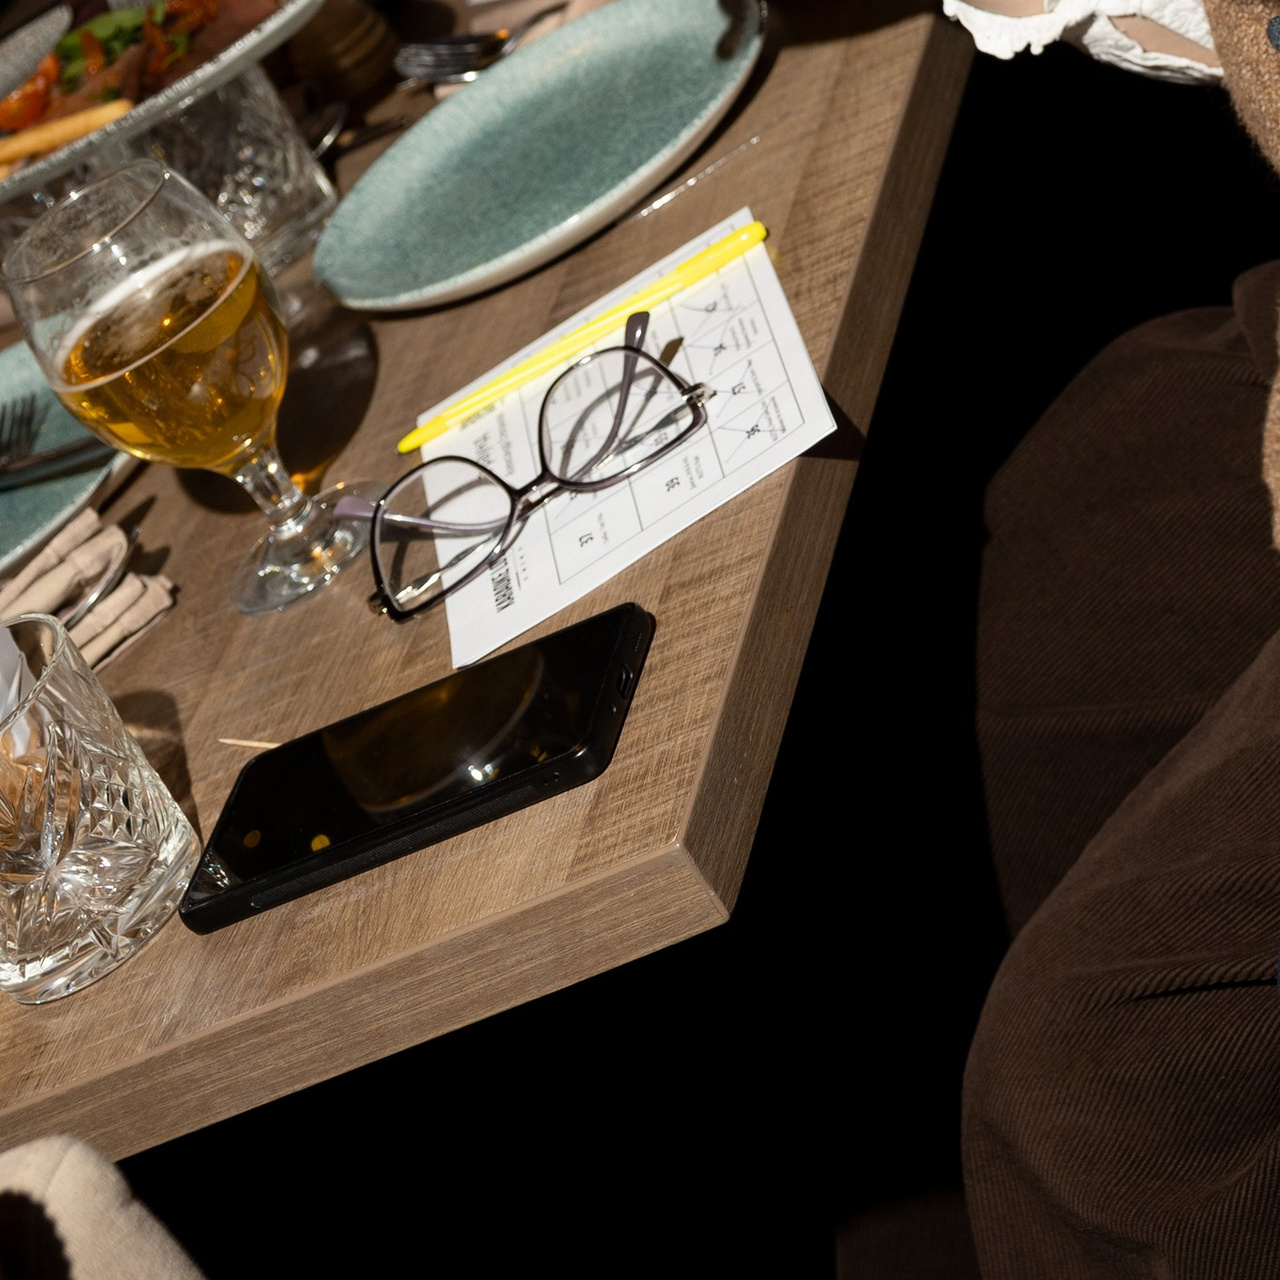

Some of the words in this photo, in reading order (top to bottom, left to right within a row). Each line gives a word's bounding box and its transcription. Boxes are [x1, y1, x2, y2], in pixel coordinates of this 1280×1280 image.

[665, 477, 680, 492] 39
[579, 532, 594, 547] 37
[491, 568, 515, 614] KARAOKE
